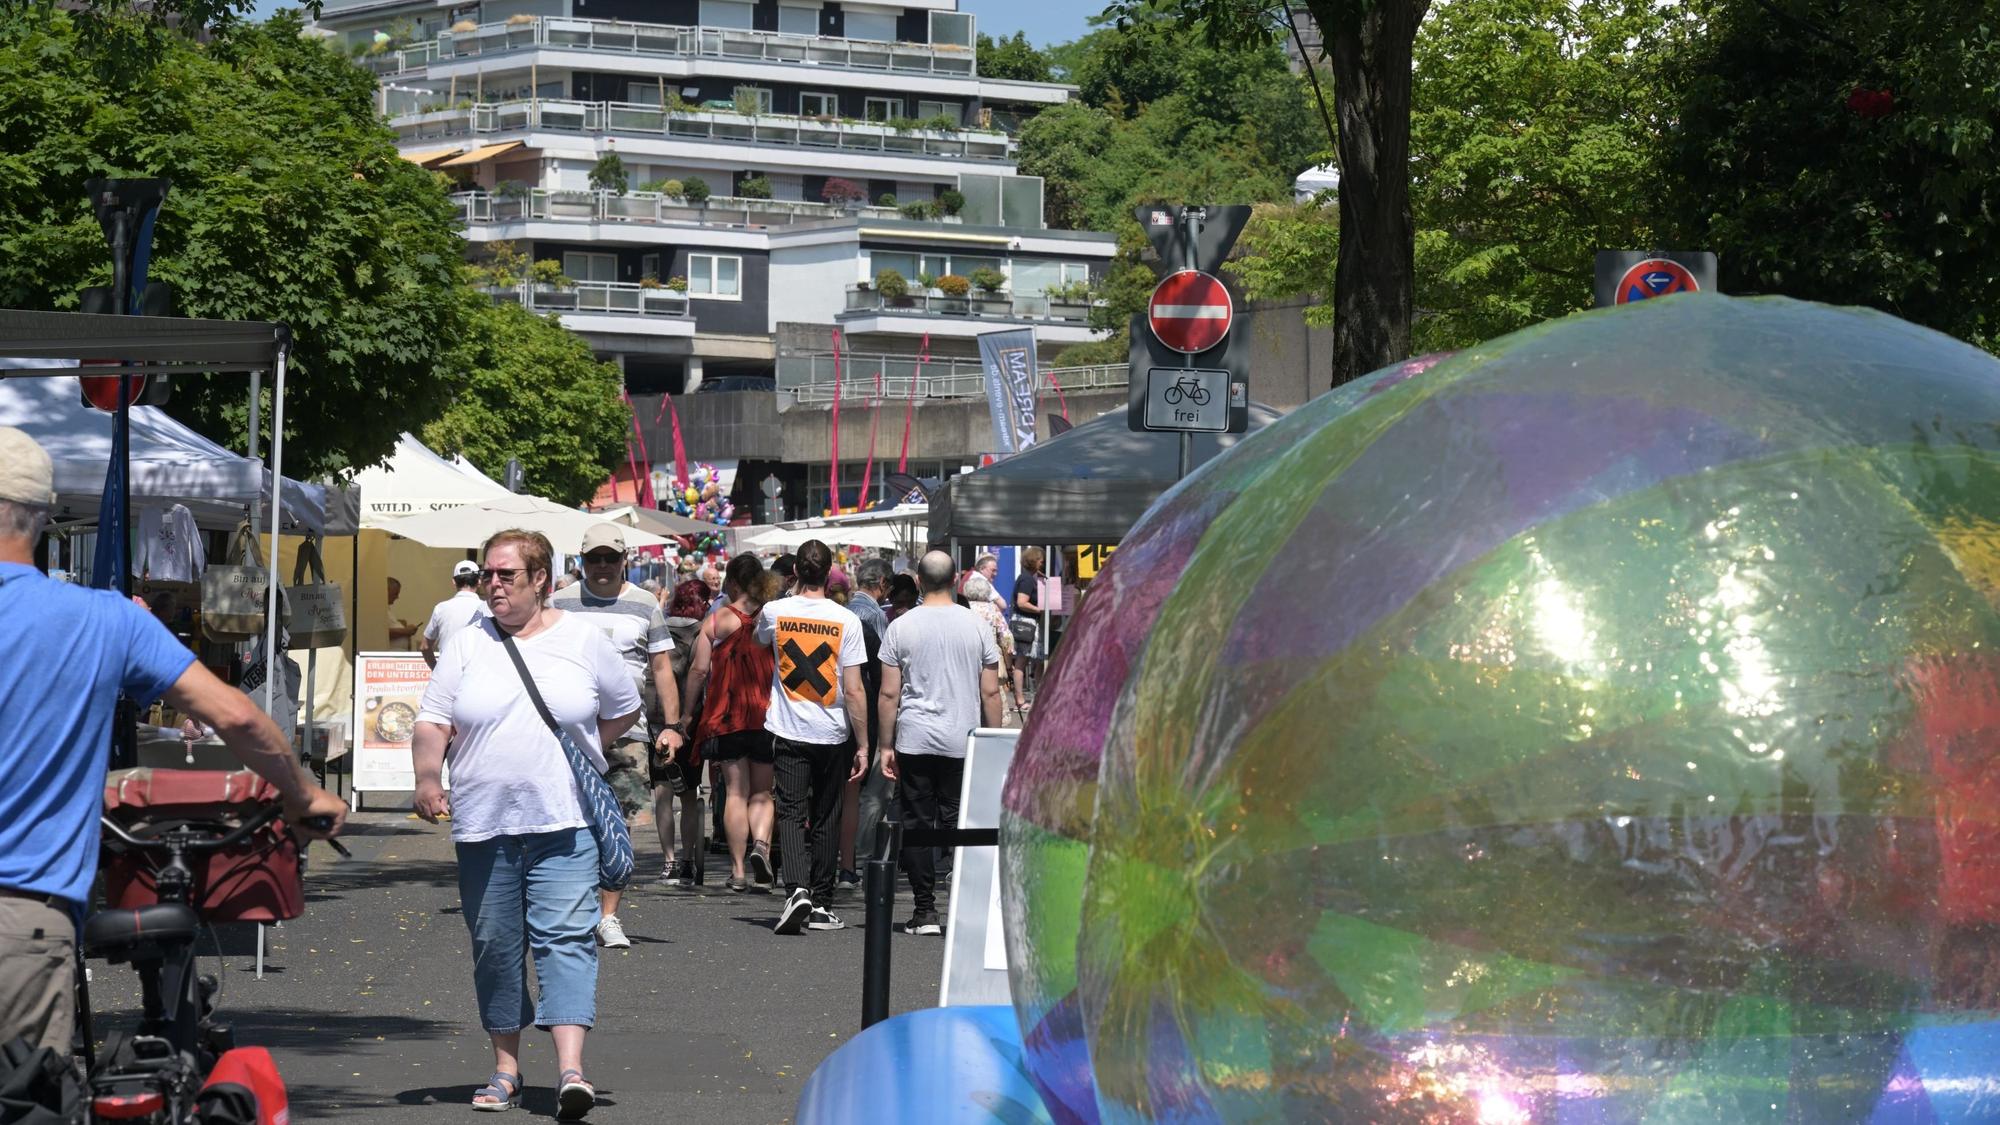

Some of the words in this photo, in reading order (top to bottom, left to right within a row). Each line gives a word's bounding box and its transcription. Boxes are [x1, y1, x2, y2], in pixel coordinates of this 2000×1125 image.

[1174, 408, 1201, 423] frei
[370, 502, 412, 512] WILD
[780, 621, 840, 637] WARNING
[367, 662, 395, 670] ERLEBE
[396, 662, 410, 671] MIT
[367, 671, 385, 679] DEN
